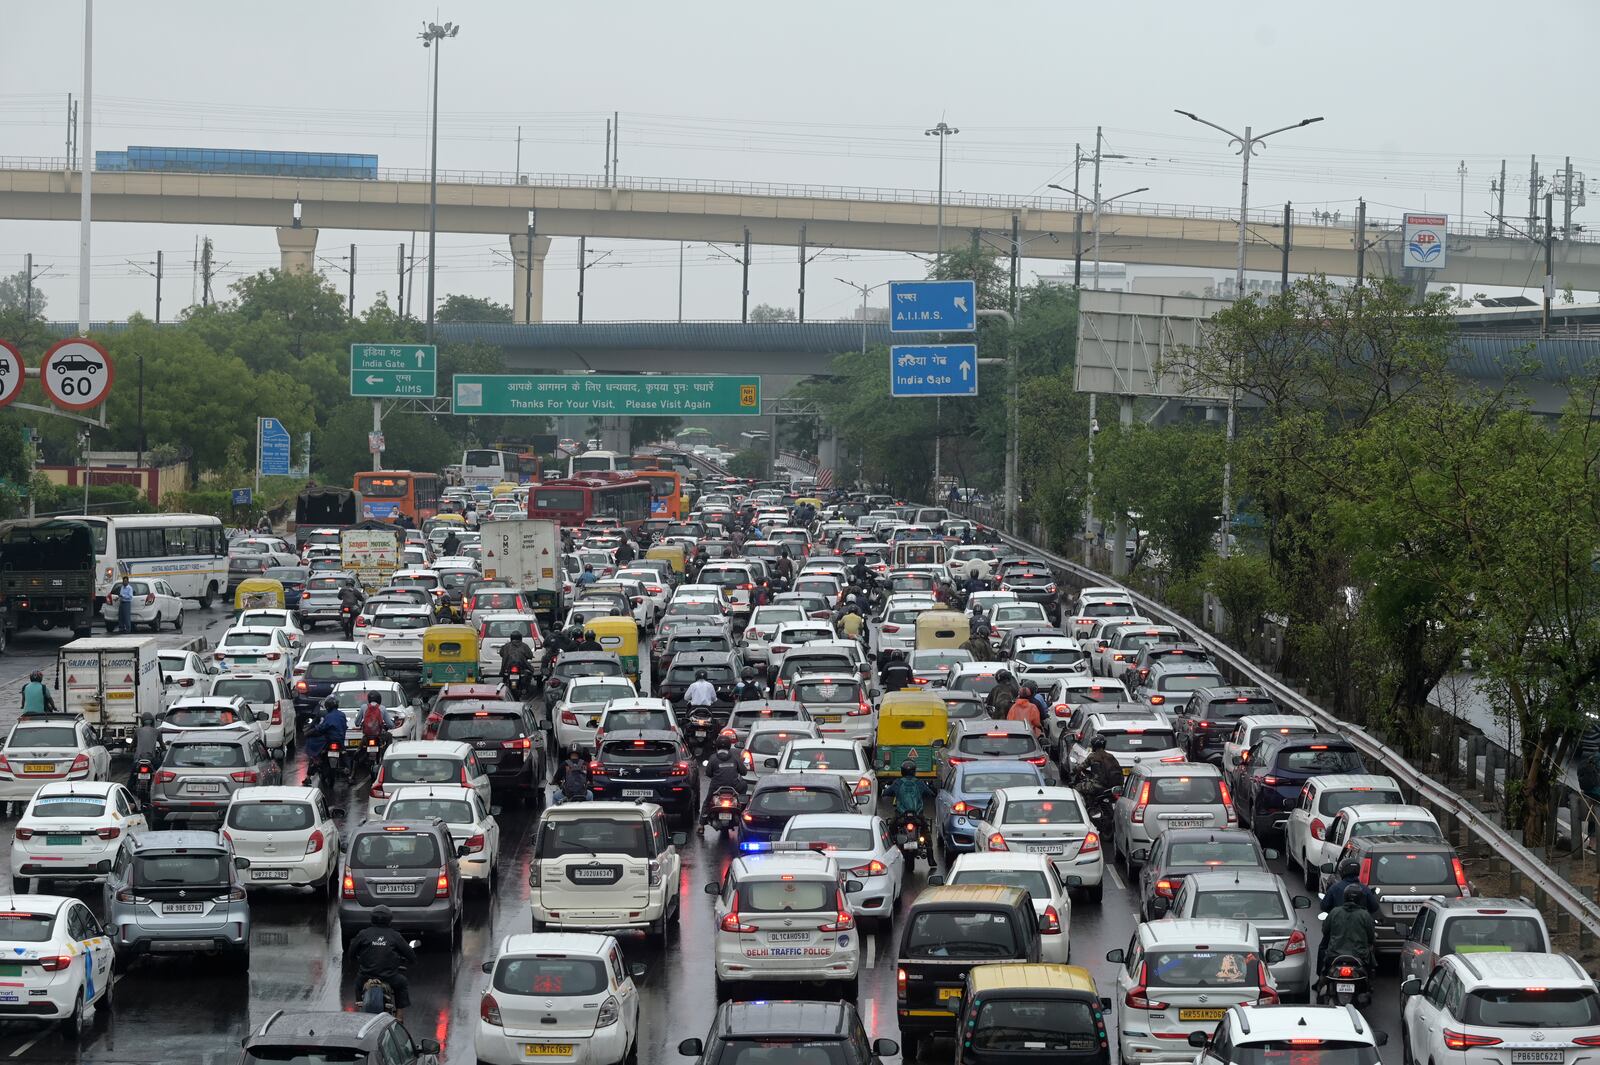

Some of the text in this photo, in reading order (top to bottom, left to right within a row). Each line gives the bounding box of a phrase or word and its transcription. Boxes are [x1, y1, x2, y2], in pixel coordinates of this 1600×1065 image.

[896, 293, 917, 304] एम्स
[896, 311, 943, 320] A.I.I.M.S.
[363, 346, 401, 358] इंडिया गेट
[362, 360, 405, 368] India Gate
[898, 354, 926, 368] इंडिया
[396, 374, 412, 383] एम्स
[897, 376, 952, 384] India Gate
[61, 377, 92, 396] 60
[395, 385, 422, 393] AIIMS
[507, 381, 532, 392] आपके
[537, 383, 567, 392] आगमन
[572, 381, 580, 391] के
[585, 381, 601, 392] लिए
[645, 384, 668, 393] कृपया
[694, 381, 714, 392] पधारें
[511, 400, 711, 410] Thanks For Your Visit. Please Visit Again
